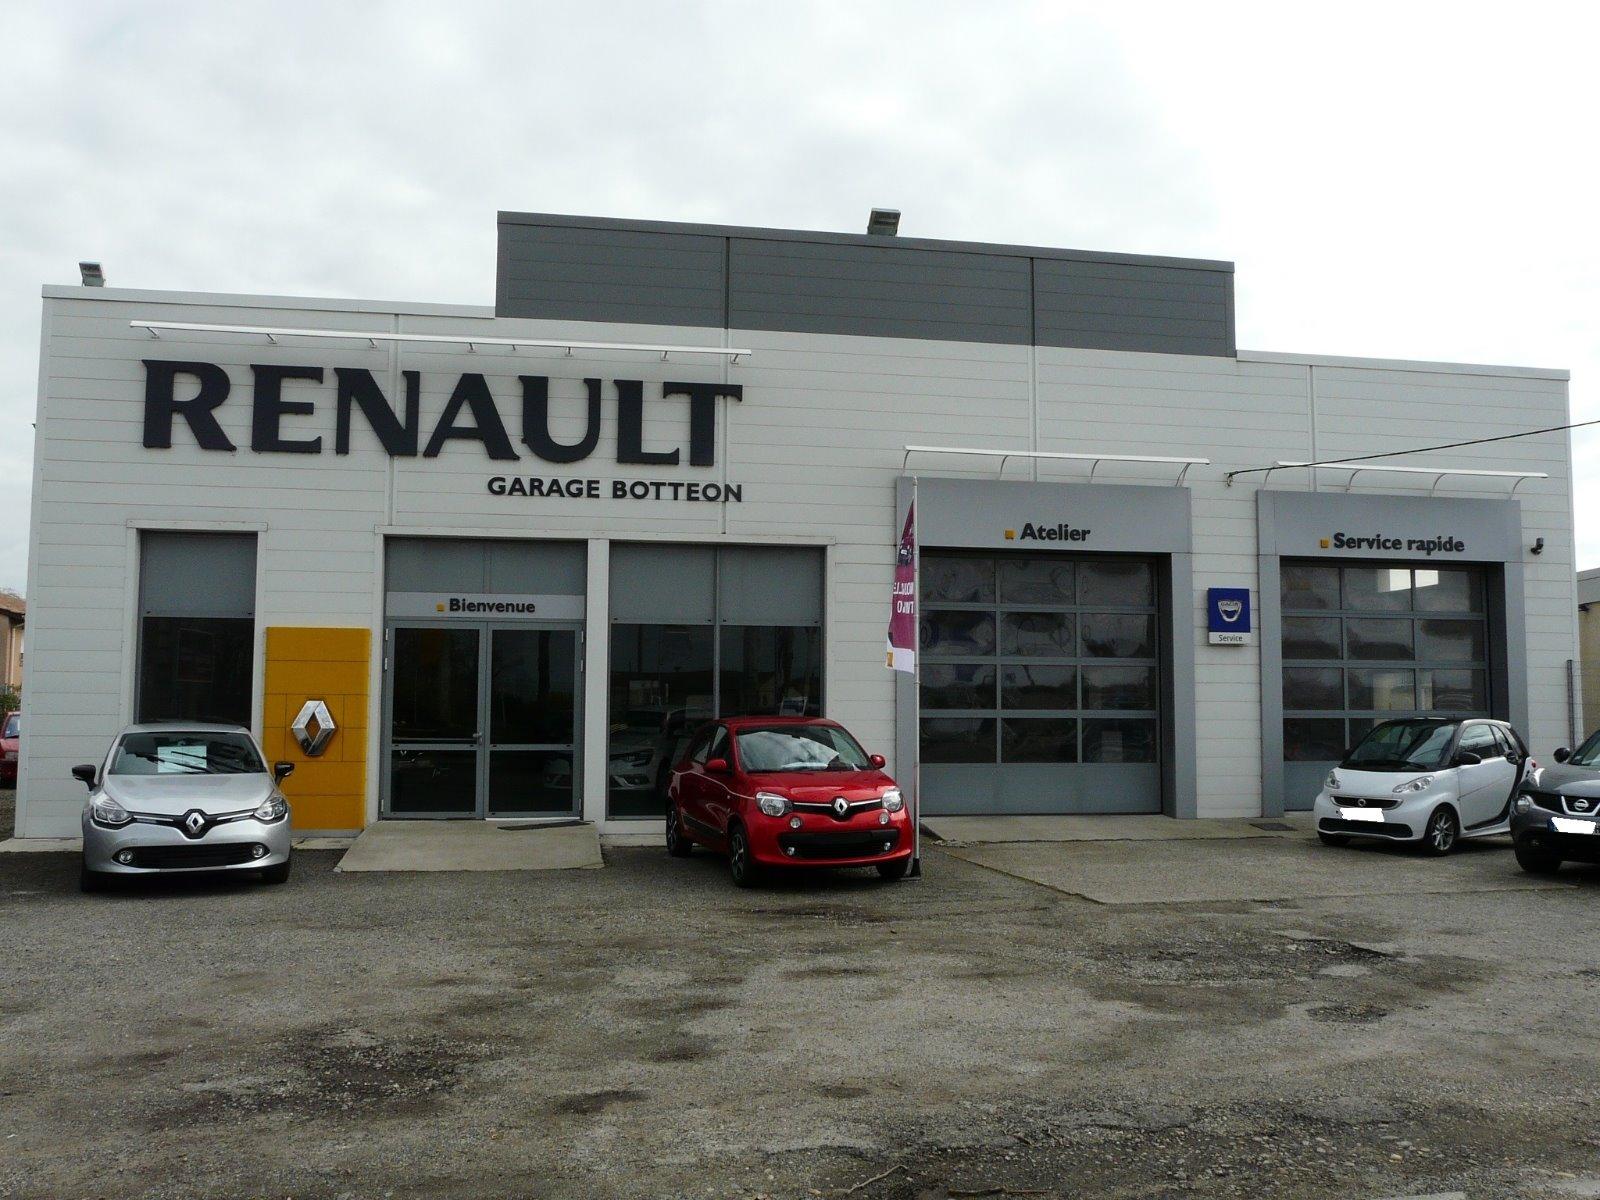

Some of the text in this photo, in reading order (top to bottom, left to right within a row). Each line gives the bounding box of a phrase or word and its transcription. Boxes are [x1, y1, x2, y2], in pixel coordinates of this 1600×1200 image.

[142, 359, 743, 466] RENAULT
[487, 476, 742, 502] GARAGE BOTTEON
[1020, 522, 1091, 541] Atelier
[1333, 532, 1465, 556] Service rapide
[449, 598, 535, 613] Bienvenue
